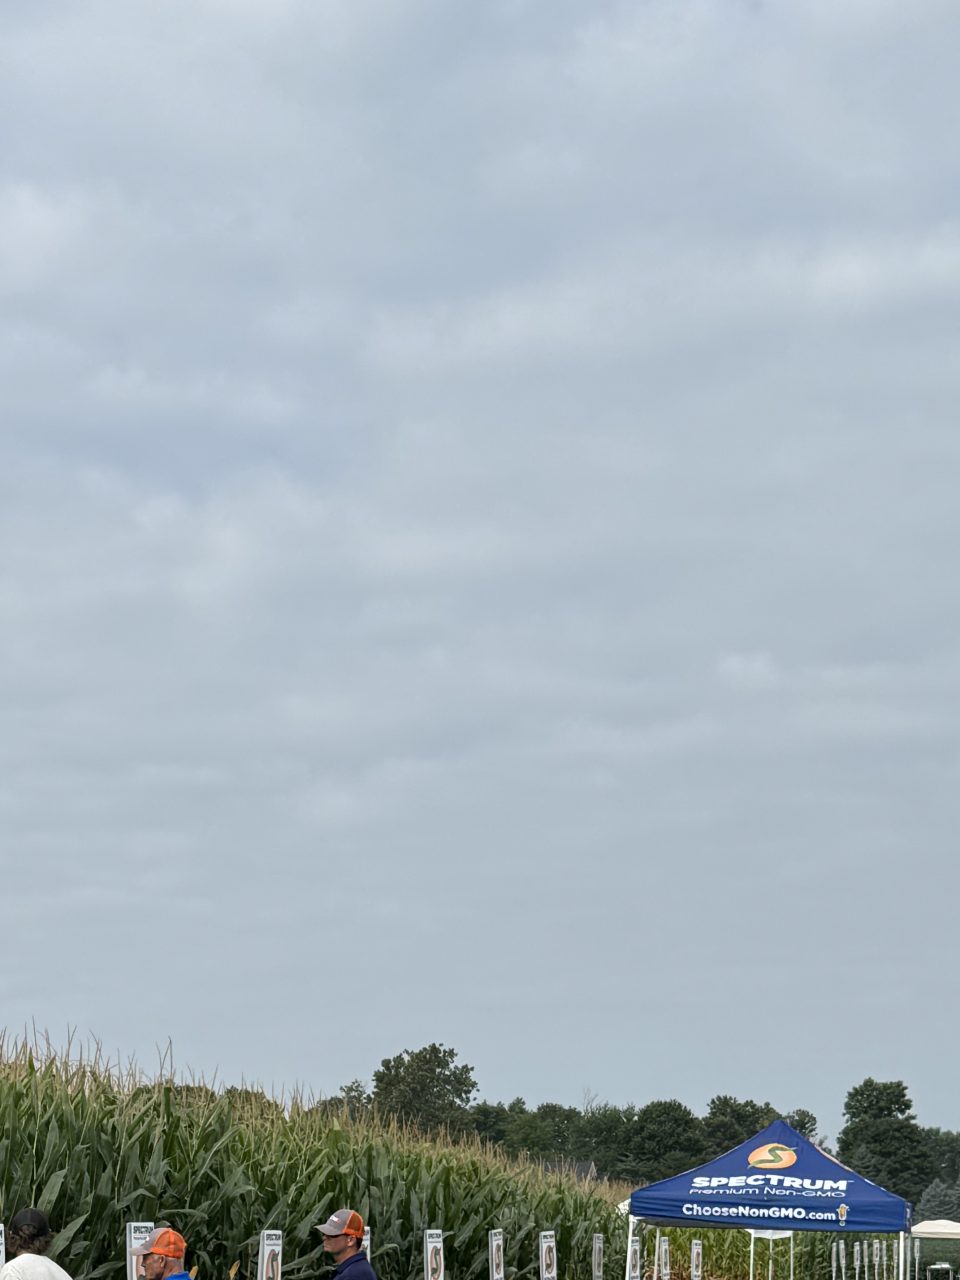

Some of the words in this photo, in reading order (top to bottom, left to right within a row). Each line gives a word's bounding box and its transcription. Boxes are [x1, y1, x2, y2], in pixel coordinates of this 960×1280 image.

[691, 1174, 847, 1191] SPECTRUM
[689, 1187, 759, 1195] Premium
[763, 1186, 846, 1198] Non-GMO
[682, 1203, 836, 1221] ChooseNonGMO.com
